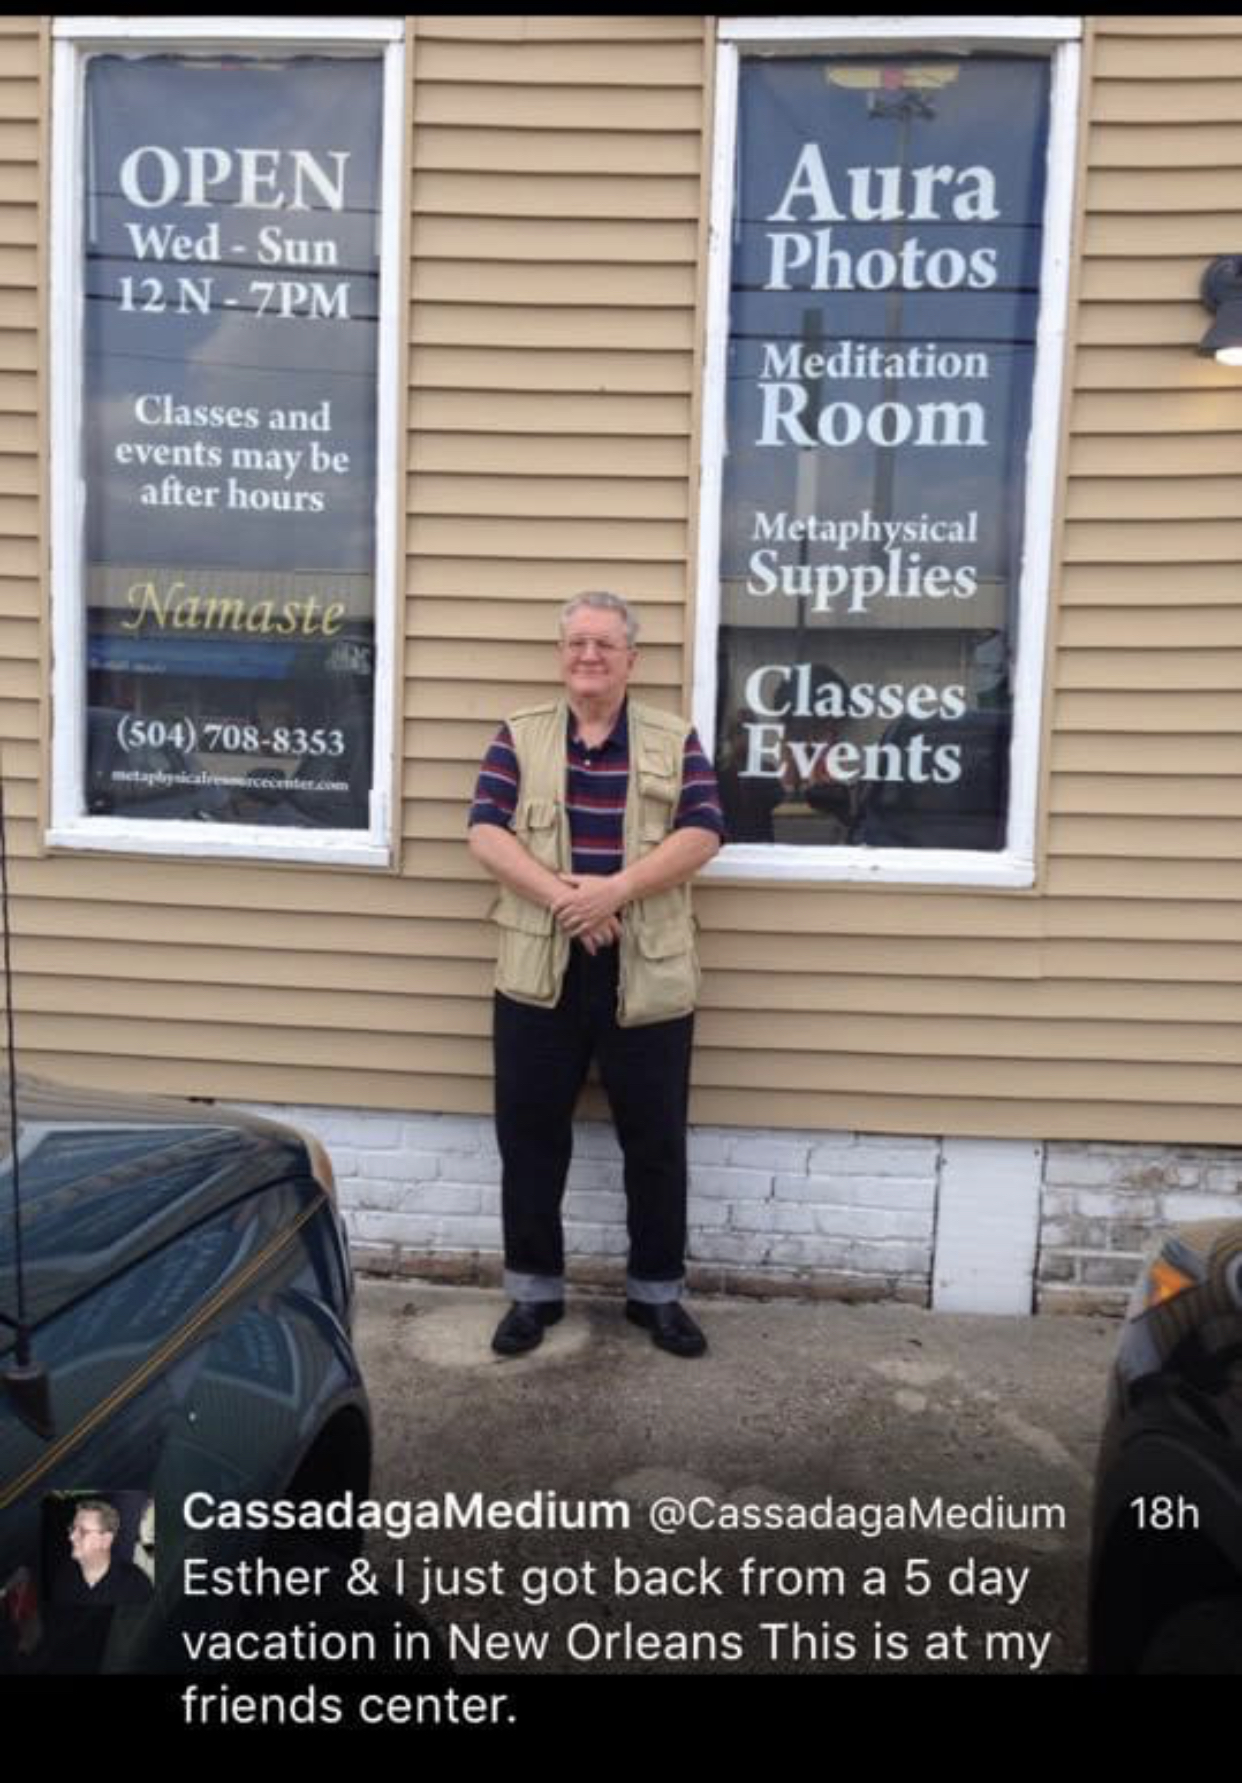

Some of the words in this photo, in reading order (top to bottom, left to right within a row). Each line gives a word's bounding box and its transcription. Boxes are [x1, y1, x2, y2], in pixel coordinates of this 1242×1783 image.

[120, 145, 350, 211] OPEN
[766, 143, 999, 222] Aura
[125, 223, 221, 261] Wed
[257, 225, 337, 265] Sun
[763, 227, 998, 290] Photos
[119, 277, 165, 313] 12
[177, 278, 212, 315] N
[250, 282, 350, 319] 7PM
[760, 341, 988, 378] Meditation
[135, 394, 259, 430] Classes
[269, 402, 331, 432] and
[755, 382, 987, 446] Room
[116, 441, 222, 467] events
[232, 449, 303, 478] may
[310, 443, 350, 473] be
[141, 476, 220, 507] after
[227, 478, 326, 512] hours
[752, 510, 978, 551] Metaphysical
[746, 549, 977, 613] Supplies
[122, 581, 346, 635] Namaste
[745, 663, 966, 720] Classes
[116, 714, 195, 753] (504)
[203, 724, 345, 755] 708-8353
[738, 722, 962, 784] Events
